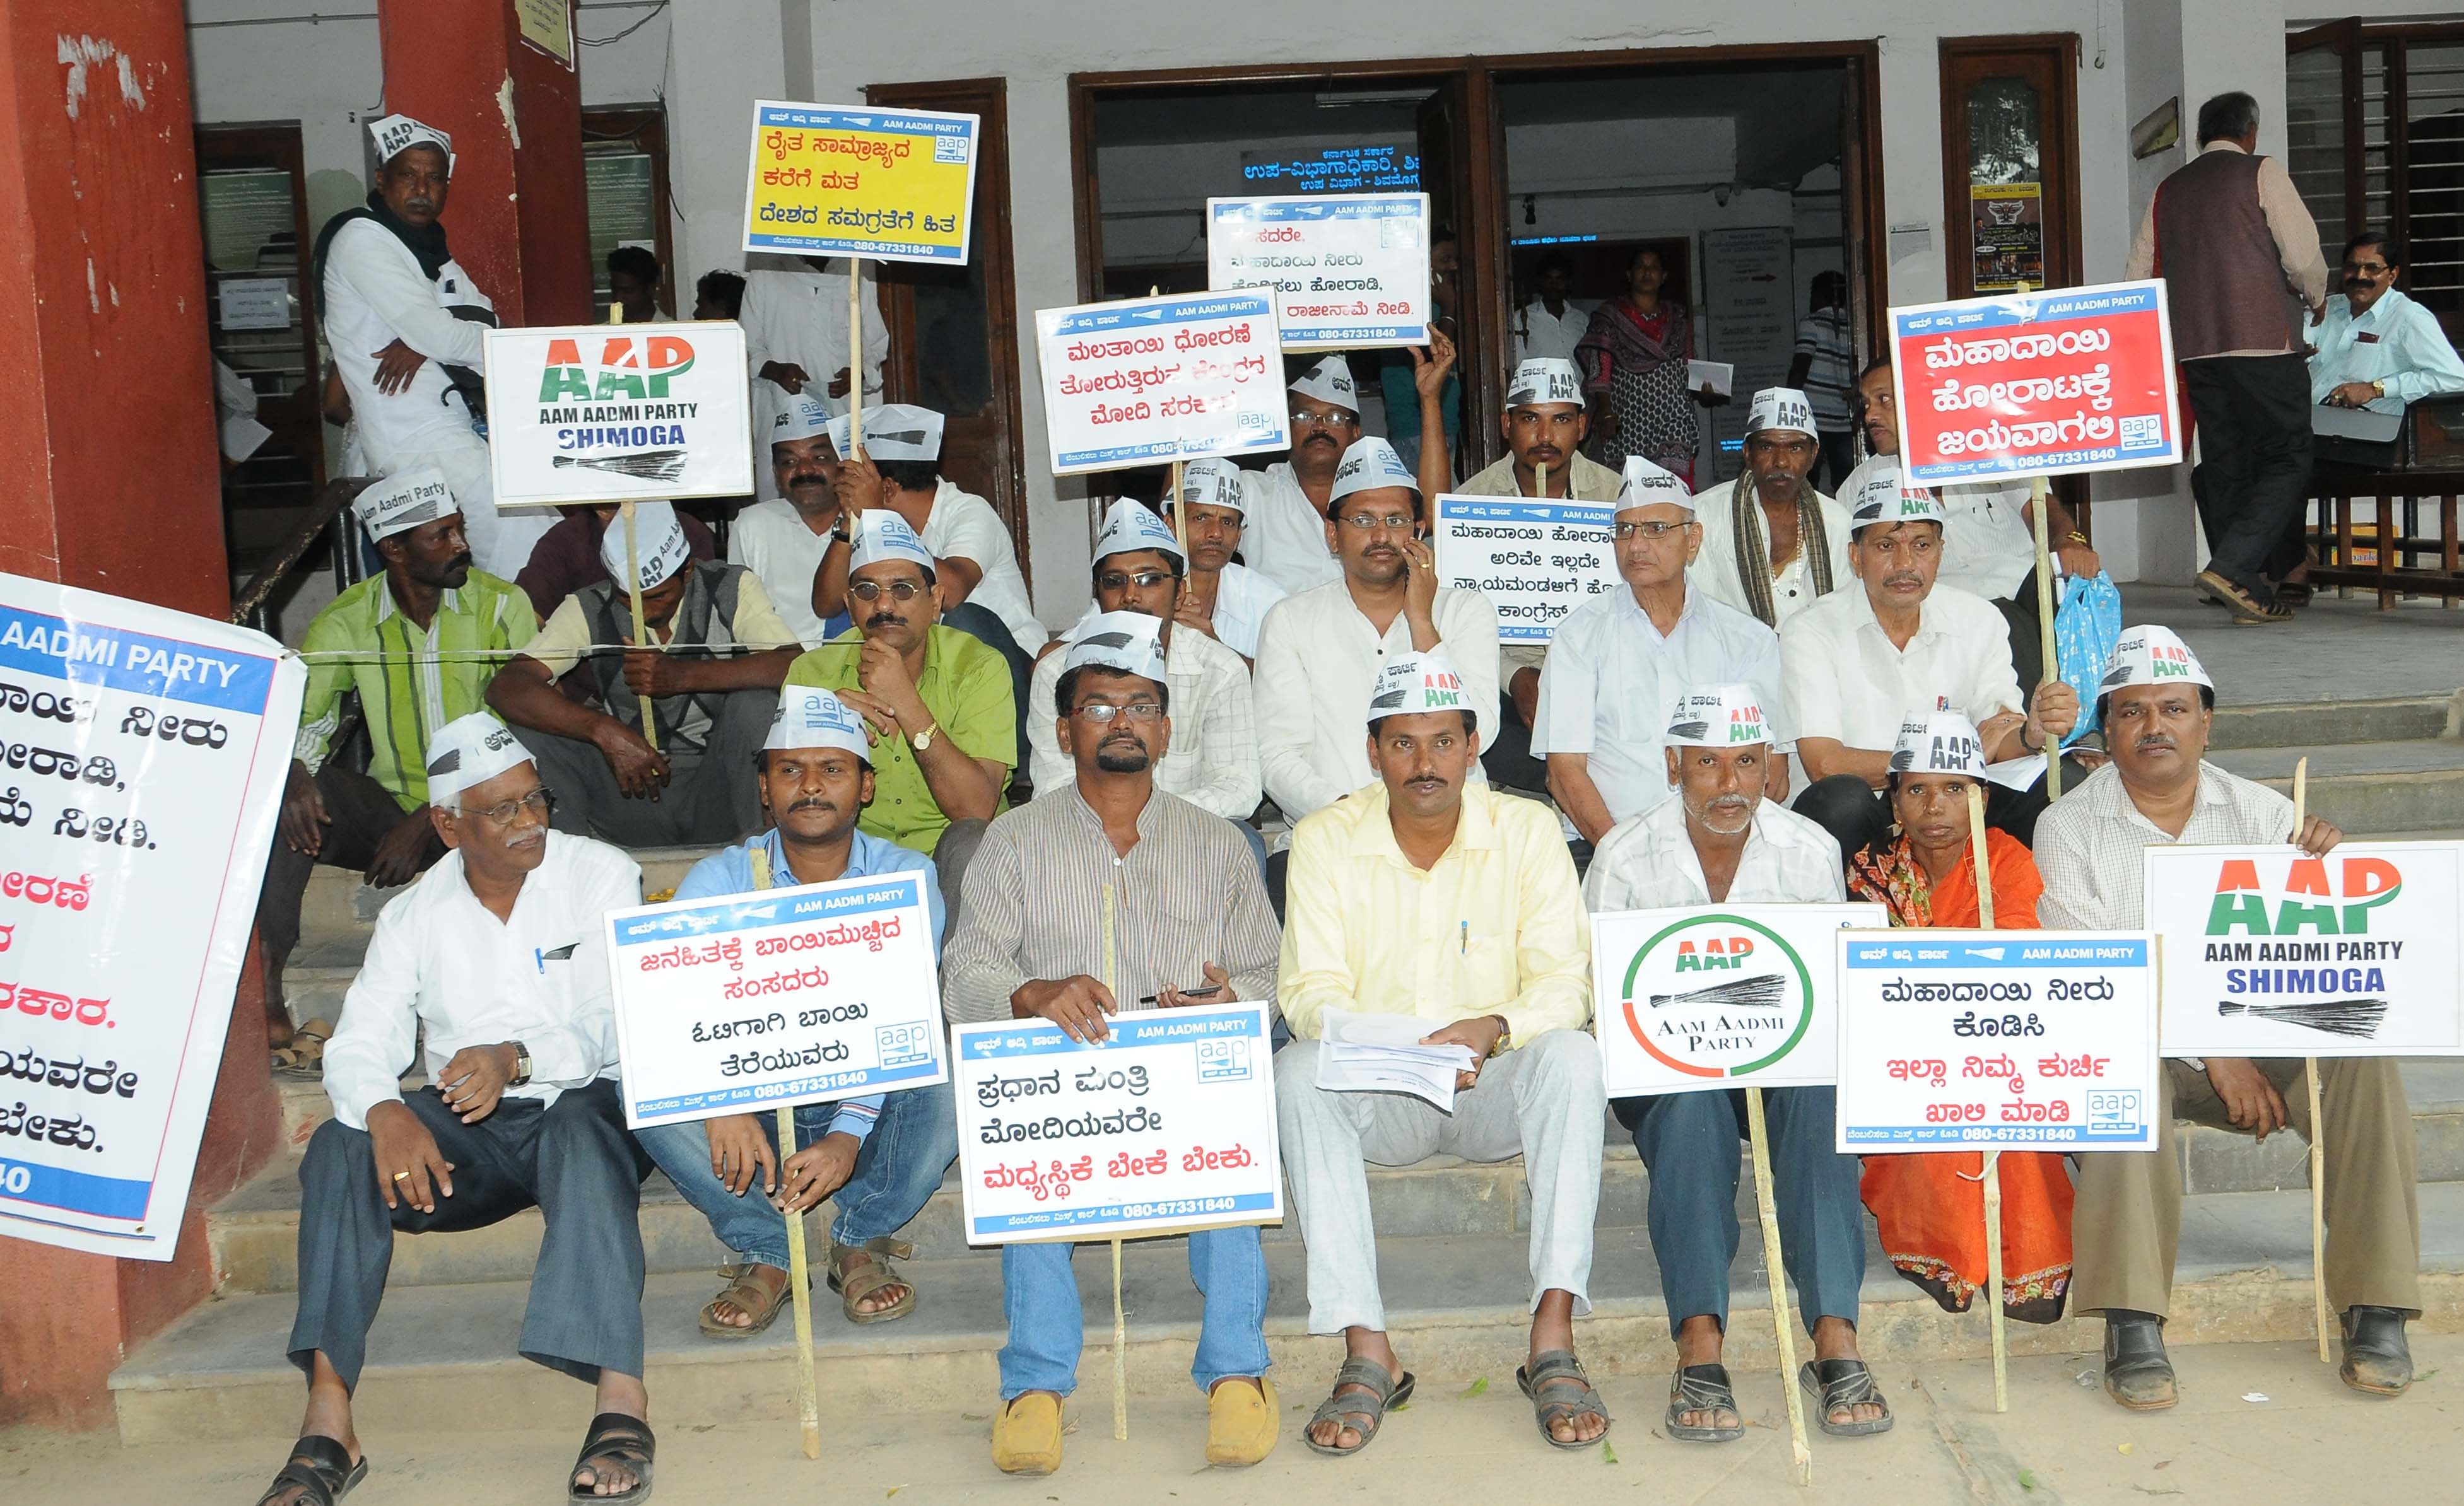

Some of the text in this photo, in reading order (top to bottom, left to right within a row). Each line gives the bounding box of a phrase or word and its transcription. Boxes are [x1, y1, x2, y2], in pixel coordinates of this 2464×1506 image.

[382, 123, 413, 155] AAP
[883, 120, 962, 132] AAM AADMI PARTY
[766, 131, 910, 168] ರೈತ ಸಾಮ್ರಾಜ್ಯದ
[937, 138, 966, 156] aap
[763, 167, 859, 190] ಕರೆಗೆ ಮತ
[1300, 178, 1324, 190] ಉಪ
[1329, 176, 1362, 190] ವಿಭಾಗ
[760, 202, 955, 234] ದೇಶದ ಸಮಗ್ರತೆಗೆ ಹಿತ
[1325, 252, 1363, 266] ನೀರು
[1176, 301, 1259, 317] AAM AADMI PARTY
[2049, 295, 2145, 313] AAM AADMI PARTY
[1067, 323, 1250, 362] ಮಲತಾಯಿ ಧೋರಣೆ
[1319, 329, 1396, 339] 080-67331840
[1924, 326, 2110, 370] ಮಹಾದಾಯಿ
[539, 336, 695, 402] AAP
[1549, 374, 1574, 399] AAP
[1932, 363, 2113, 413] ಹೋರಾಟಕ್ಕೆ
[539, 403, 698, 424] AAM AADMI PARTY
[1090, 401, 1151, 425] ಮೋದಿ
[1776, 402, 1807, 428] AAP
[558, 424, 686, 450] SHIMOGA
[1937, 410, 2114, 455] ಜಯವಾಗಲಿ
[2123, 418, 2158, 442] aap
[2019, 448, 2116, 468] 080-67331840
[1216, 476, 1242, 506] AAP
[1641, 472, 1677, 488] ಆಮ್
[380, 491, 413, 513] Aadmi
[414, 482, 445, 499] Party
[1900, 487, 1930, 515] AAP
[1583, 512, 1610, 520] AADMI
[660, 535, 675, 557] Aam
[1452, 523, 1614, 543] ಮಹಾದಾಯಿ ಹೋರಾ
[639, 556, 663, 588] AP
[1491, 551, 1600, 573] ಅರಿವೇ ಇಲ್ಲದೇ
[1498, 603, 1568, 622] ಕಾಂಗ್ರೆಸ್
[1, 621, 240, 688] AADMI PARTY
[2152, 647, 2188, 677] AAP
[1425, 674, 1459, 707] AAP
[120, 706, 228, 750] ನೀರು
[1730, 706, 1761, 742] AAP
[1930, 736, 1971, 769] AAP
[794, 889, 904, 914] AAM AADMI PARTY
[2205, 858, 2402, 935] AAP
[640, 915, 900, 972] ಜನಹಿತಕ್ಕೆ ಬಾಯಿಮುಚ್ಚಿದ
[1675, 937, 1754, 972] AAP
[2022, 948, 2134, 959] AAM AADMI PARTY
[2205, 941, 2403, 962] AAM AADMI PARTY
[724, 966, 829, 1001] ಸಂಸದರು
[1882, 976, 2115, 1003] ಮಹಾದಾಯಿ ನೀರು
[2227, 968, 2386, 993] SHIMOGA
[691, 1001, 868, 1044] ಓಟಿಗಾಗಿ ಬಾಯಿ
[1137, 1019, 1247, 1039] AAM AADMI PARTY
[1953, 1011, 2045, 1037] ಕೊಡಿಸಿ
[880, 1026, 925, 1055] aap
[720, 1040, 849, 1077] ತೆರೆಯುವರು
[1200, 1042, 1246, 1069] aap
[754, 1071, 867, 1099] 080-67331840
[978, 1065, 1149, 1107] ಪ್ರಧಾನ ಮಂತ್ರಿ
[1887, 1052, 2111, 1093] ಇಲ್ಲಾ ನಿಮ್ಮ ಕುರ್ಚಿ
[1926, 1097, 2070, 1123] ಖಾಲಿ ಮಾಡಿ
[2092, 1095, 2136, 1123] aap
[980, 1106, 1162, 1145] ಮೋದಿಯವರೇ
[1962, 1128, 2075, 1140] 080-67331840
[984, 1155, 1093, 1200] ಮಧ್ಯಸ್ಥಿಕೆ
[1108, 1150, 1168, 1179] ಬೇಕೆ
[1123, 1198, 1235, 1218] 080-67331840
